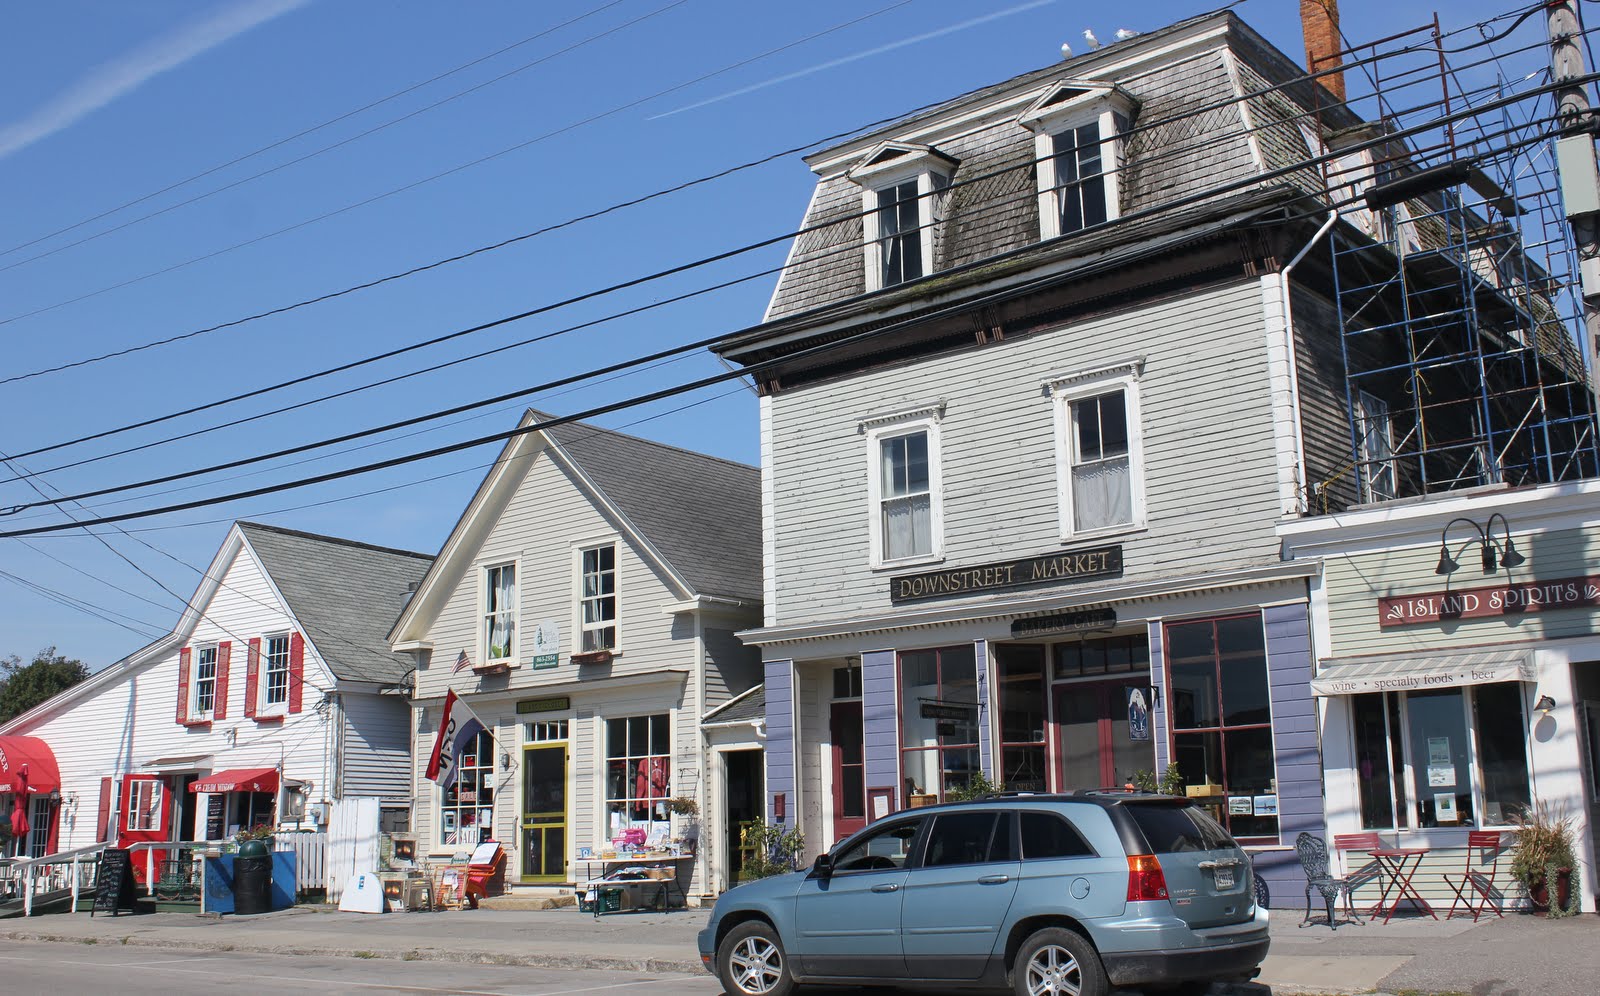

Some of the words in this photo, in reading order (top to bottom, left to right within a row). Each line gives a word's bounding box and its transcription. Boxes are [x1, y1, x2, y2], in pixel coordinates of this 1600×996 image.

[900, 565, 1015, 597] DOWNSTREET
[1032, 551, 1110, 580] MARKET
[1407, 594, 1480, 618] ISLAND
[1489, 583, 1579, 609] SPIRITS
[1021, 617, 1067, 635] BAKERY
[1331, 680, 1357, 692] wine
[1374, 675, 1420, 690] specialty
[1424, 673, 1454, 685] foods
[1471, 669, 1496, 681] beer
